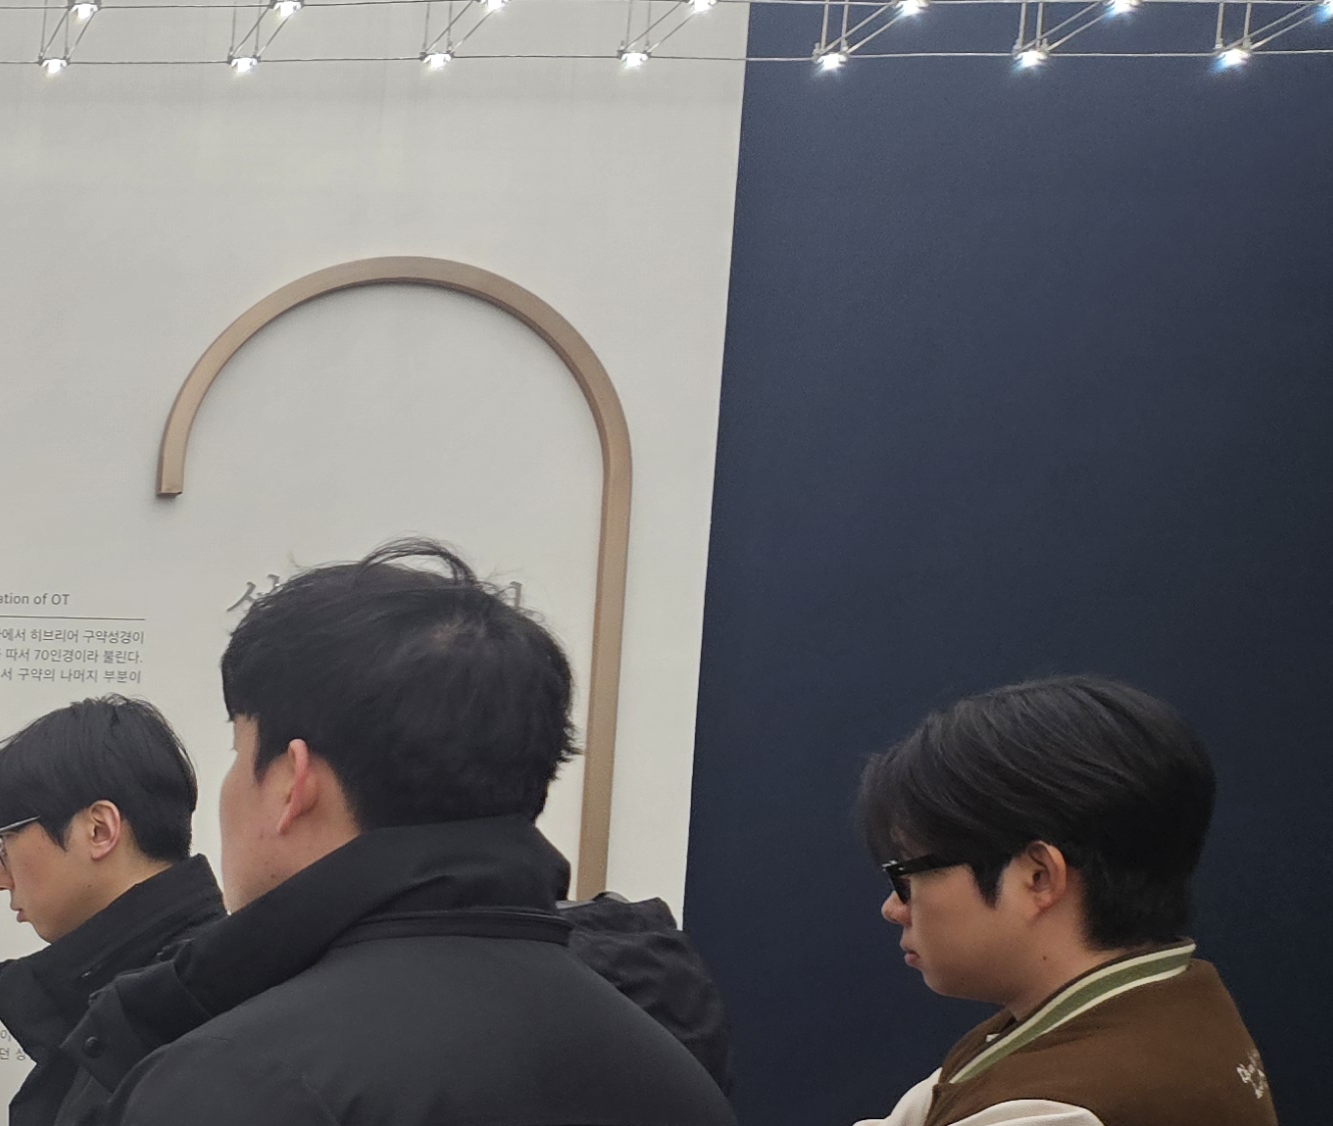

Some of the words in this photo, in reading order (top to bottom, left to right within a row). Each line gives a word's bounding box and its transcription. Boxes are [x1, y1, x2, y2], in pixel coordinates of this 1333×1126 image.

[33, 593, 48, 605] of
[51, 594, 70, 606] OT
[30, 629, 79, 643] 히브리어
[82, 630, 144, 645] 구약성경이
[5, 648, 30, 662] 따서
